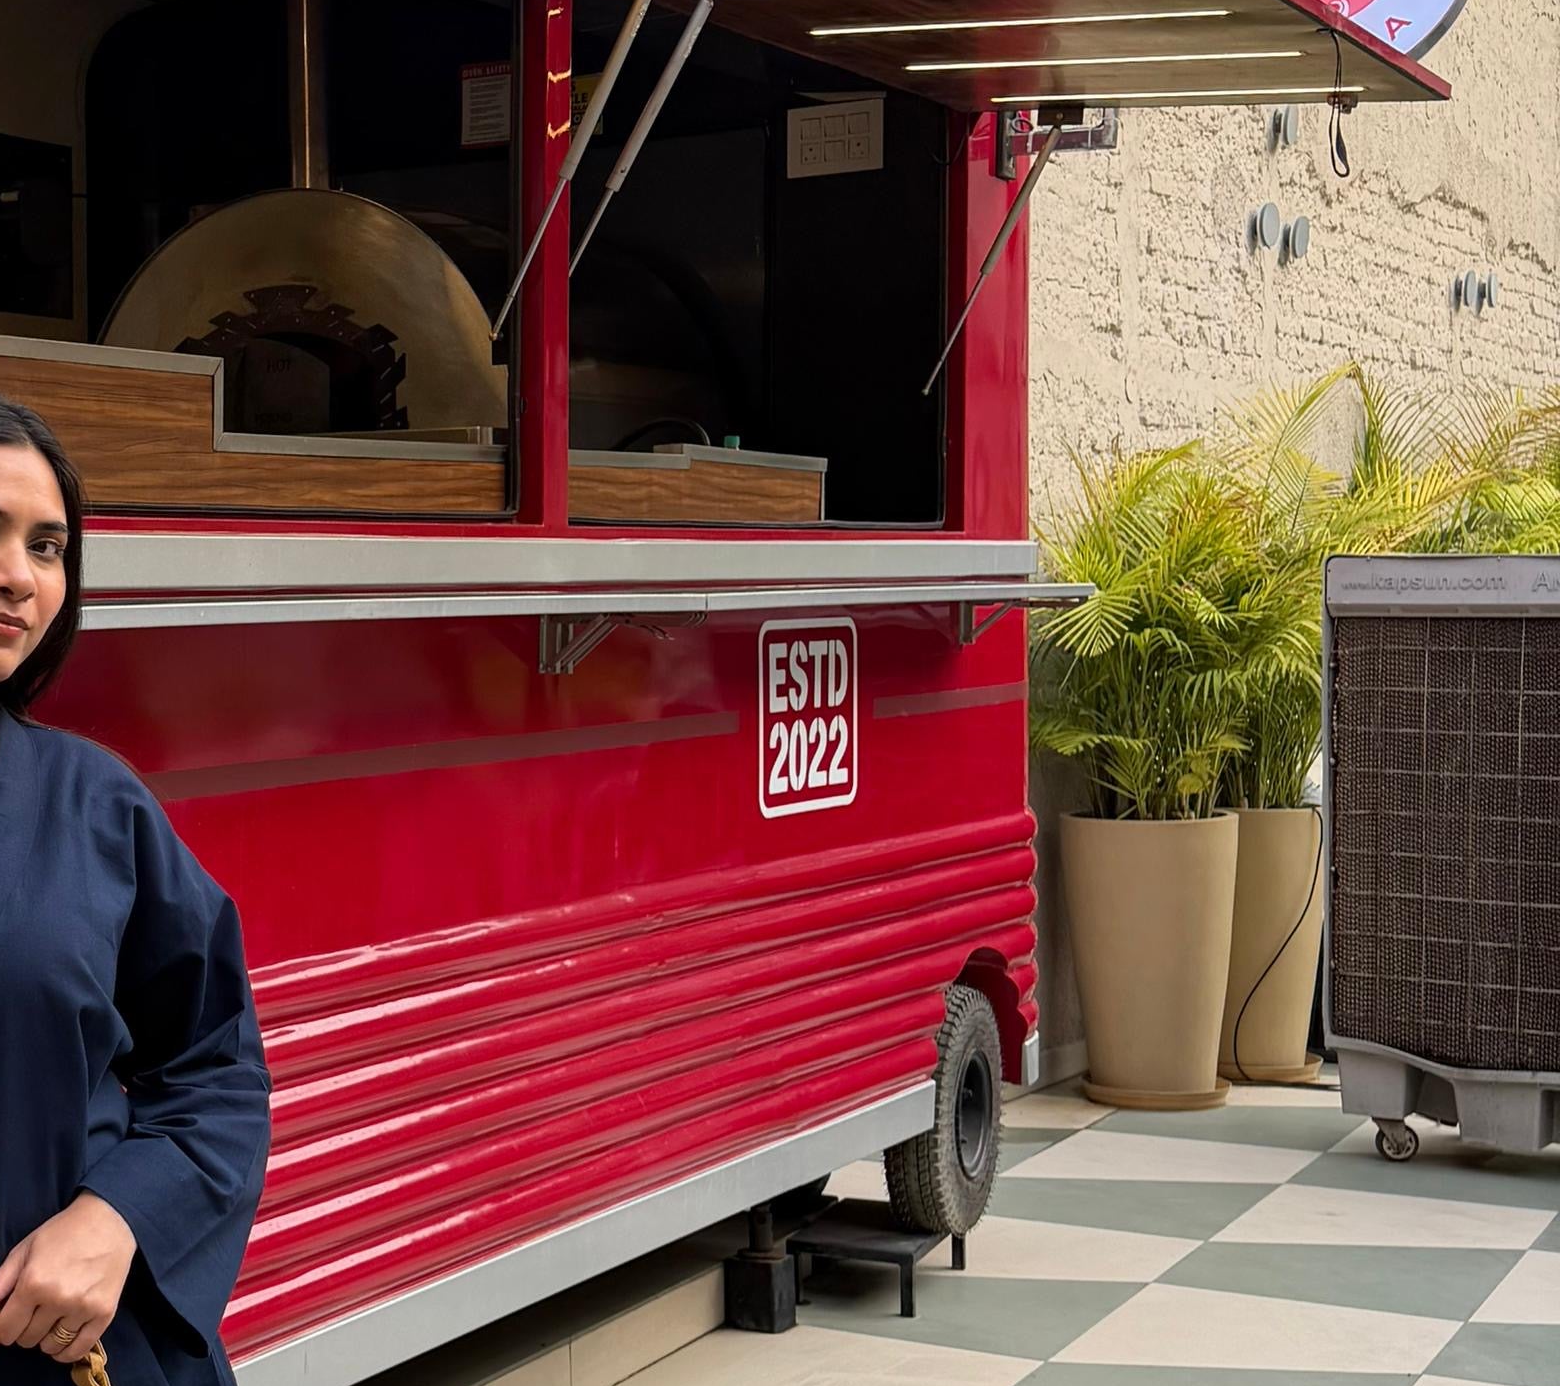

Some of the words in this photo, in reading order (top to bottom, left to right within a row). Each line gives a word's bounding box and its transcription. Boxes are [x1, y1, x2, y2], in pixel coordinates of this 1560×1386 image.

[1341, 573, 1506, 594] www.kapsun.com
[768, 639, 849, 713] ESTD
[768, 715, 849, 795] 2022
